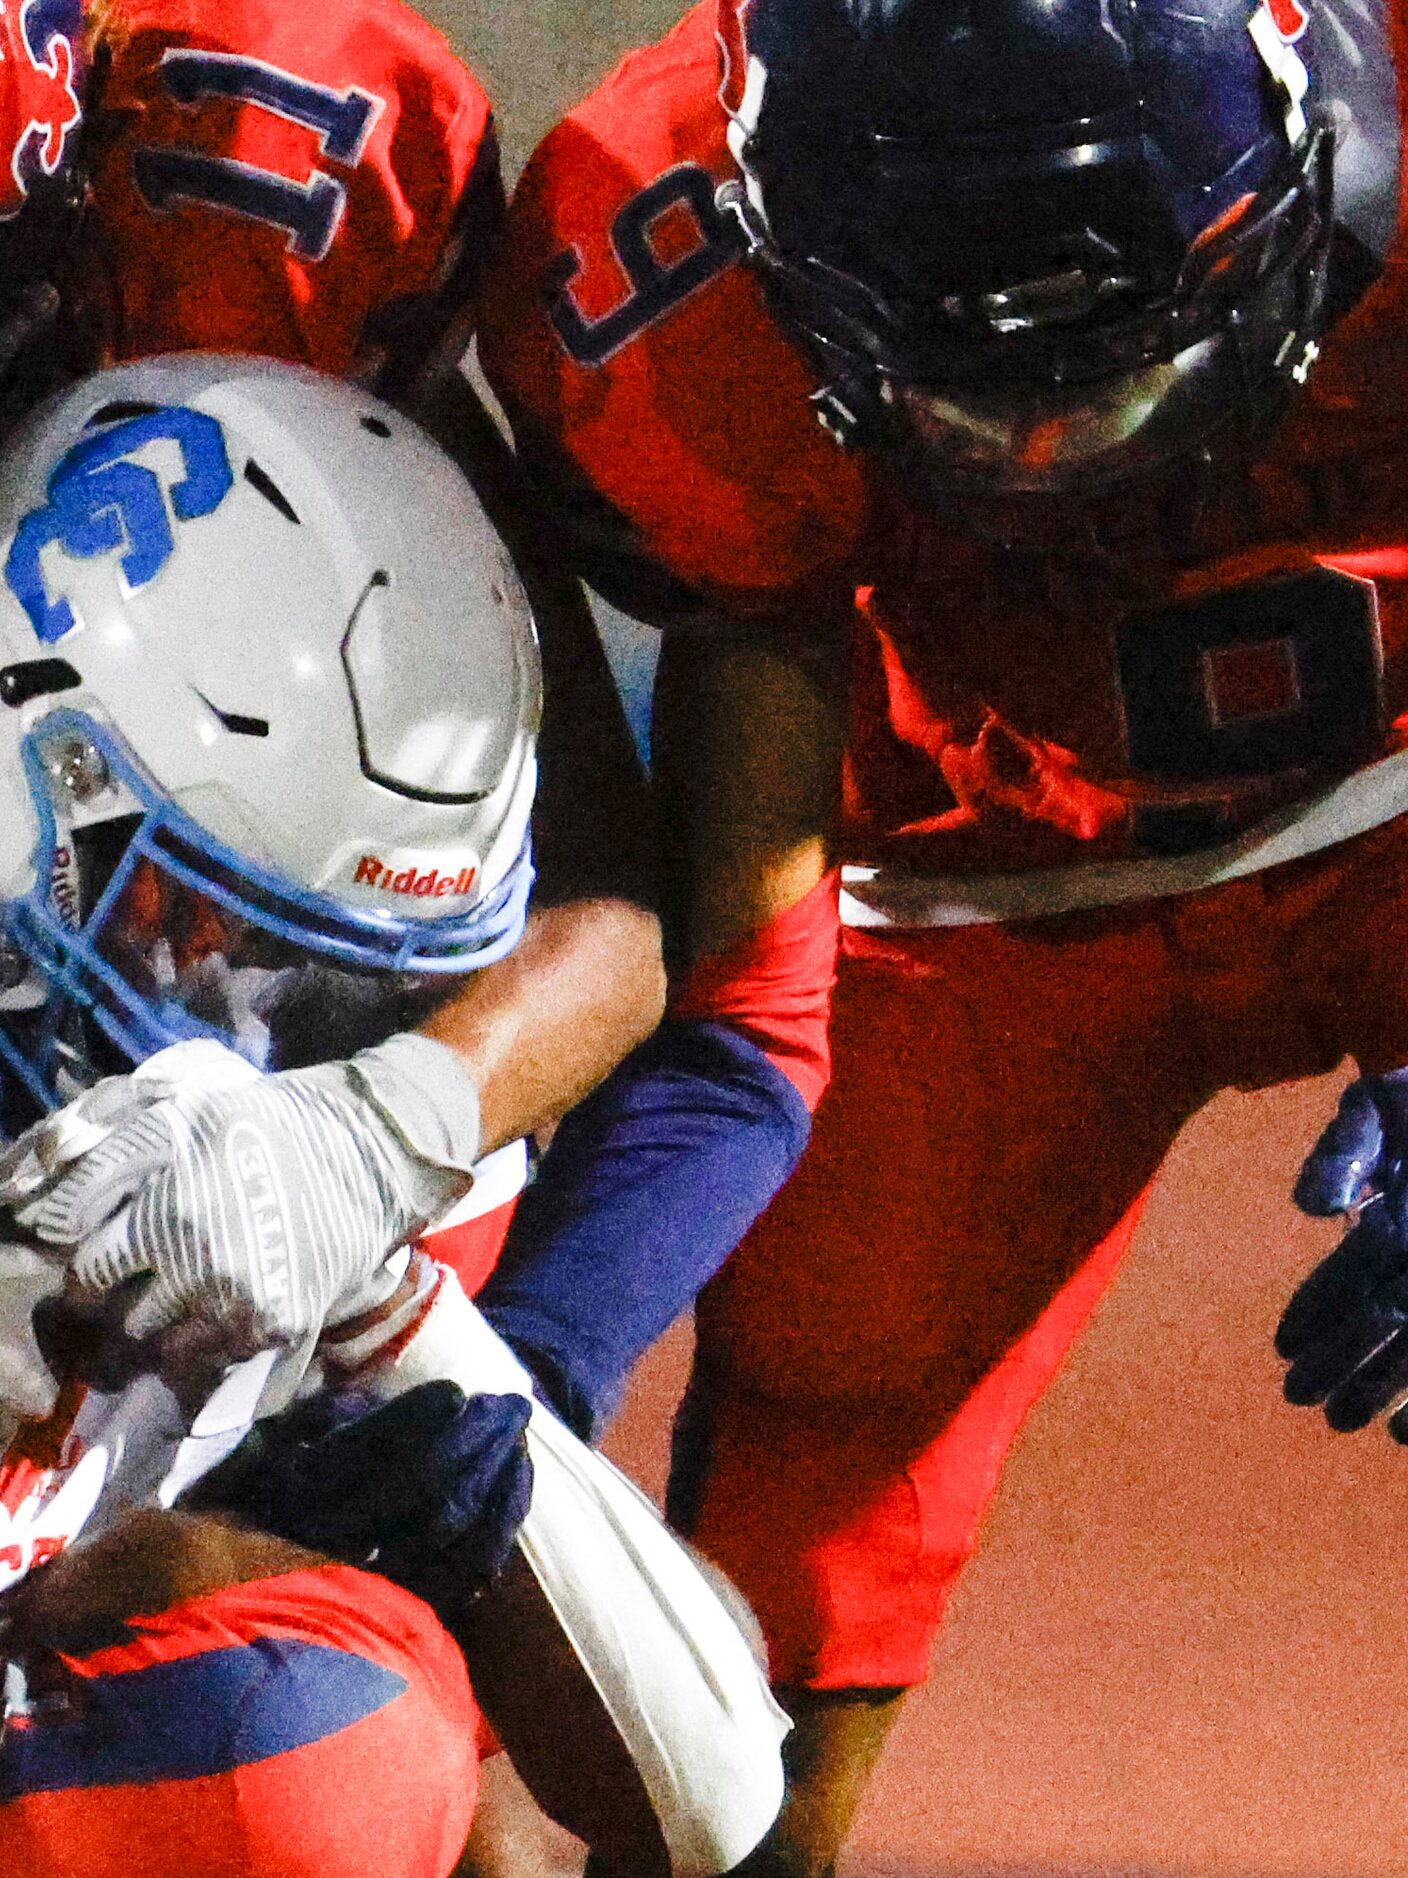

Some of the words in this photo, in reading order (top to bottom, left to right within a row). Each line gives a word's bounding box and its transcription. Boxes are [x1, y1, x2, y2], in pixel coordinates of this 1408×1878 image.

[133, 47, 387, 262] 11
[542, 160, 742, 368] 9
[353, 854, 477, 897] Riddell
